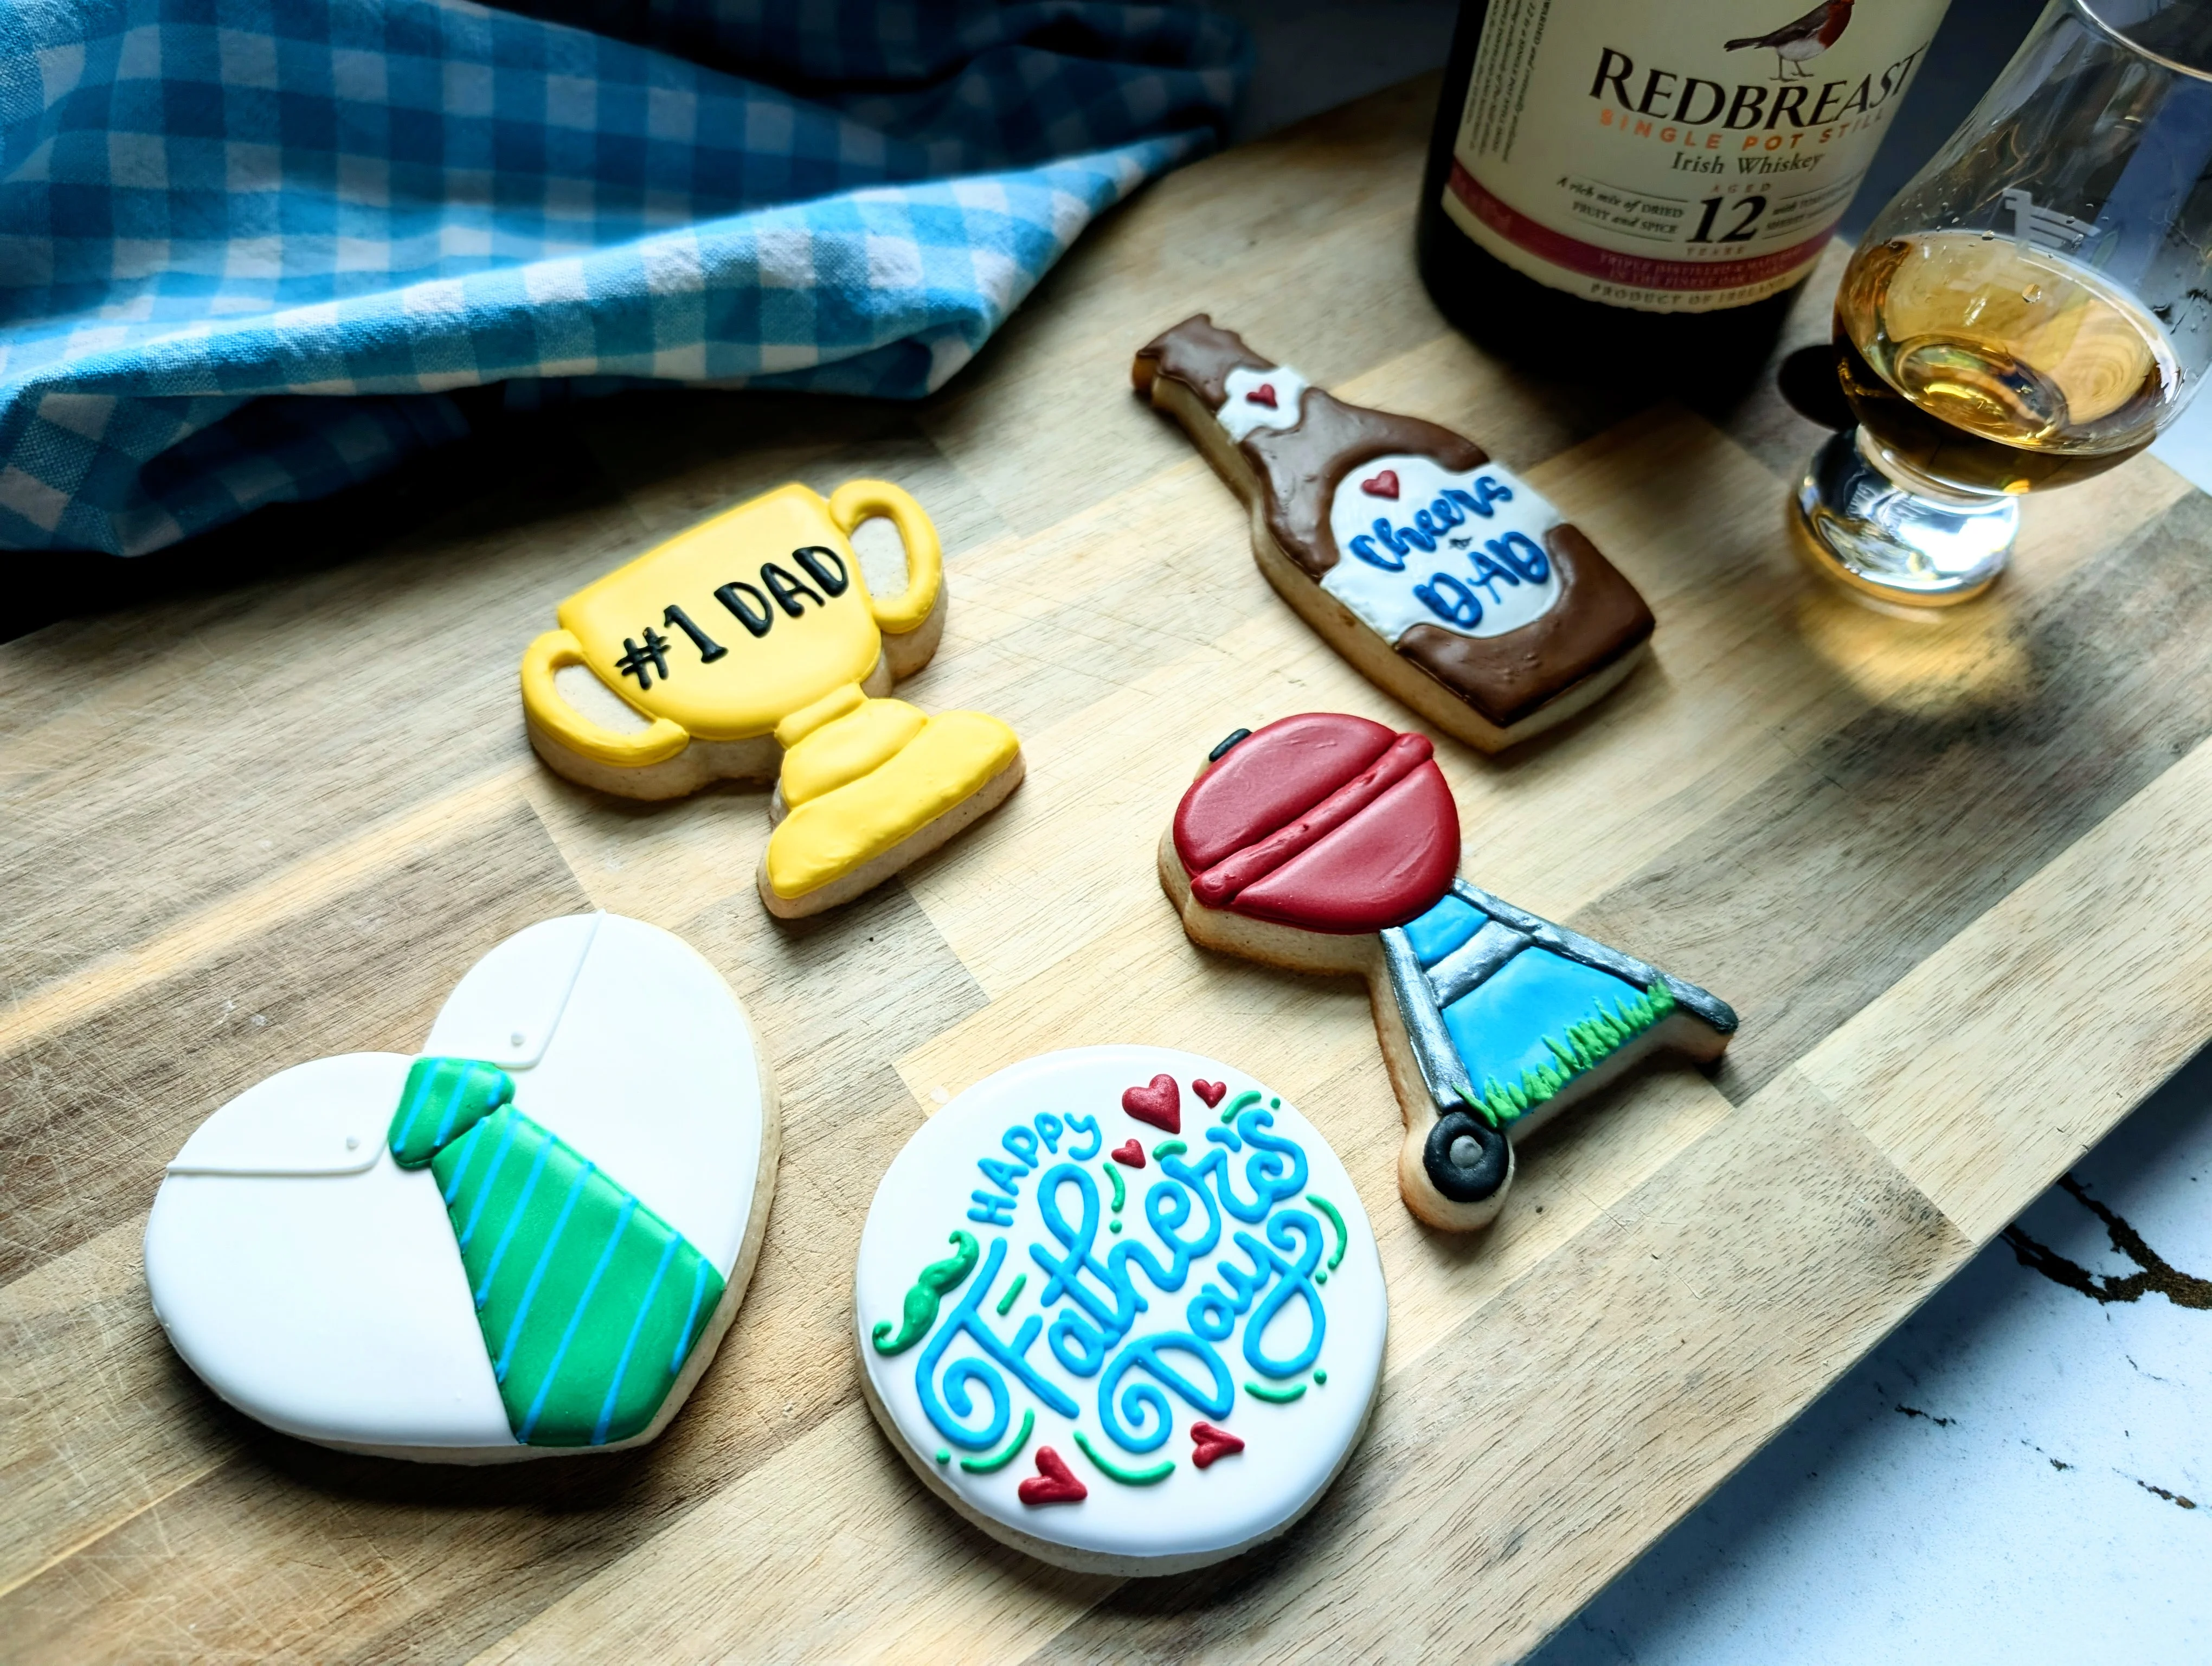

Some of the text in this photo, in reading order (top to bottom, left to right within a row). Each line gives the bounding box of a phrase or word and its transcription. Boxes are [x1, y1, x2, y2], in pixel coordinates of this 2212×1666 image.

[1589, 41, 1930, 130] REDBREAST
[1599, 109, 1882, 151] SINGLE POT STILL
[1671, 151, 1825, 175] Irish Whiskey
[1557, 176, 1568, 188] A
[1570, 183, 1594, 197] rich
[1624, 200, 1642, 213] of
[1641, 203, 1684, 218] DRIED
[1710, 183, 1772, 193] AGED
[1572, 201, 1679, 234] FRUIT and SPICE
[1685, 195, 1767, 244] 12
[1591, 283, 1681, 305] PRODUCT
[1688, 293, 1713, 305] OF
[1349, 476, 1514, 573] Cheers
[1413, 530, 1550, 629] DAD
[615, 546, 850, 691] #1 DAD
[916, 1109, 1308, 1450] Father's
[1098, 1209, 1326, 1453] Day
